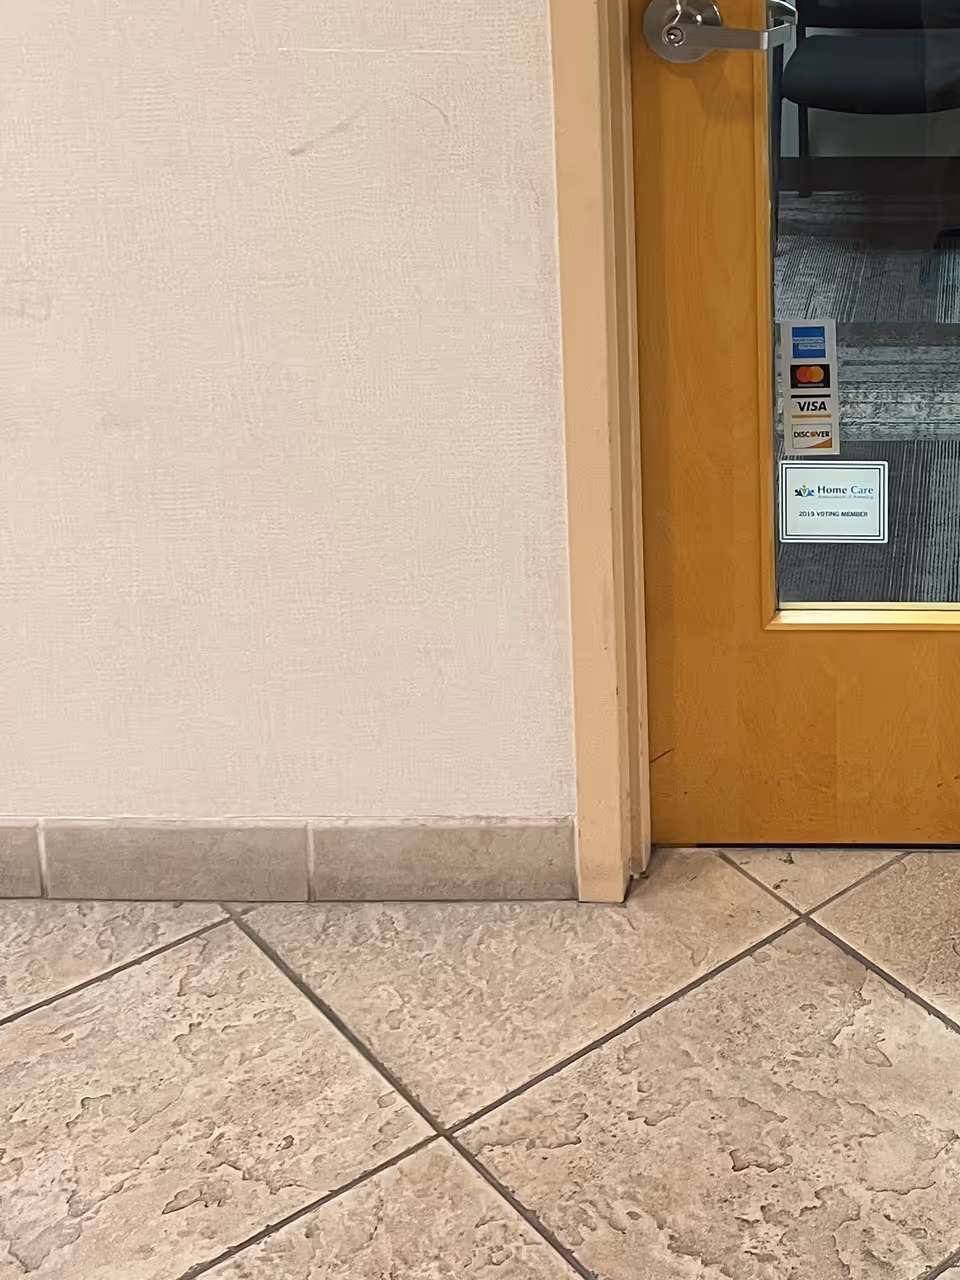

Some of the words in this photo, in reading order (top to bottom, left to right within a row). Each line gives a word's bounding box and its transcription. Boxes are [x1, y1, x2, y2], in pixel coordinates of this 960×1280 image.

[797, 401, 827, 412] VISA
[817, 485, 848, 494] Home
[850, 485, 874, 495] Care
